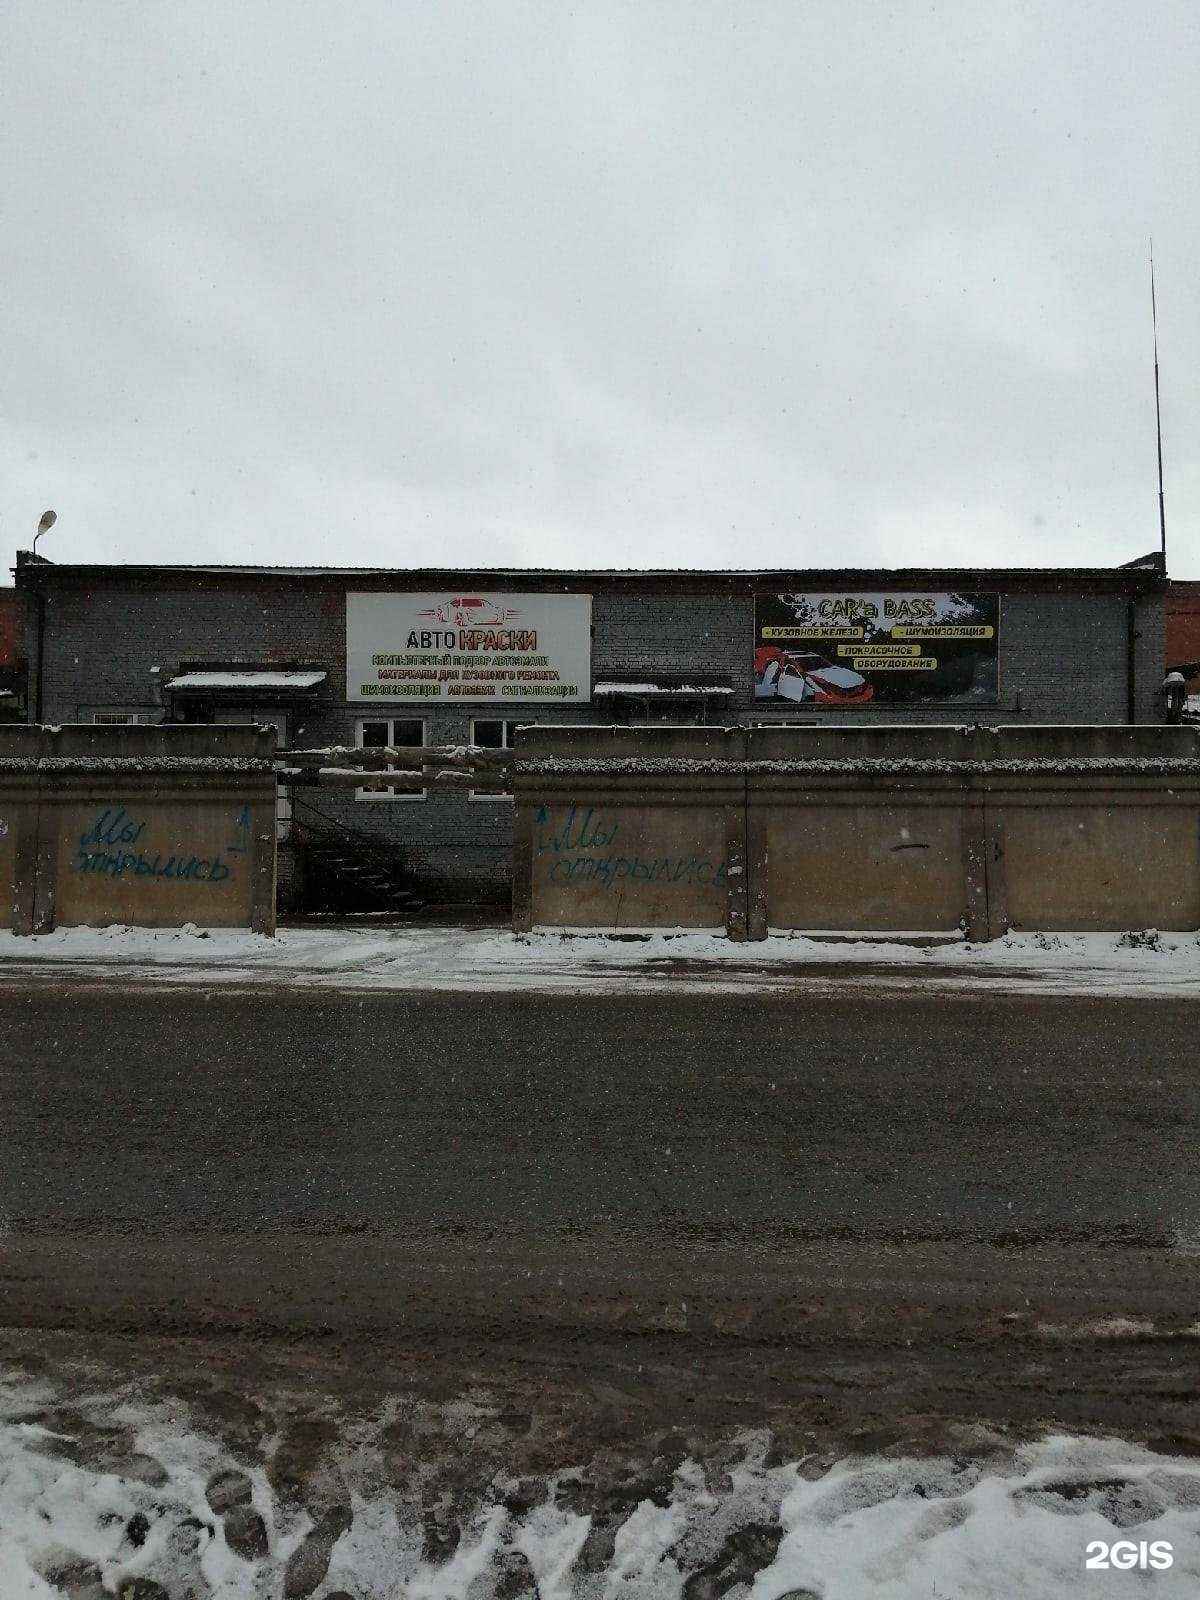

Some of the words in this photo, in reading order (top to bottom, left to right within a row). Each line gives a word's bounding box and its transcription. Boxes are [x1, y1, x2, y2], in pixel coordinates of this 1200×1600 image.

[883, 598, 936, 619] BASS
[771, 627, 819, 637] КУЗОВНОЕ
[821, 627, 859, 637] ЖЕЛЕЗО
[406, 630, 456, 649] АВТО
[458, 629, 538, 651] КРАСКИ
[844, 645, 913, 656] ПОКРАСОЧНОЕ
[857, 659, 933, 670] ОБОРУДОВАНИЕ
[438, 669, 460, 682] ДЛЯ
